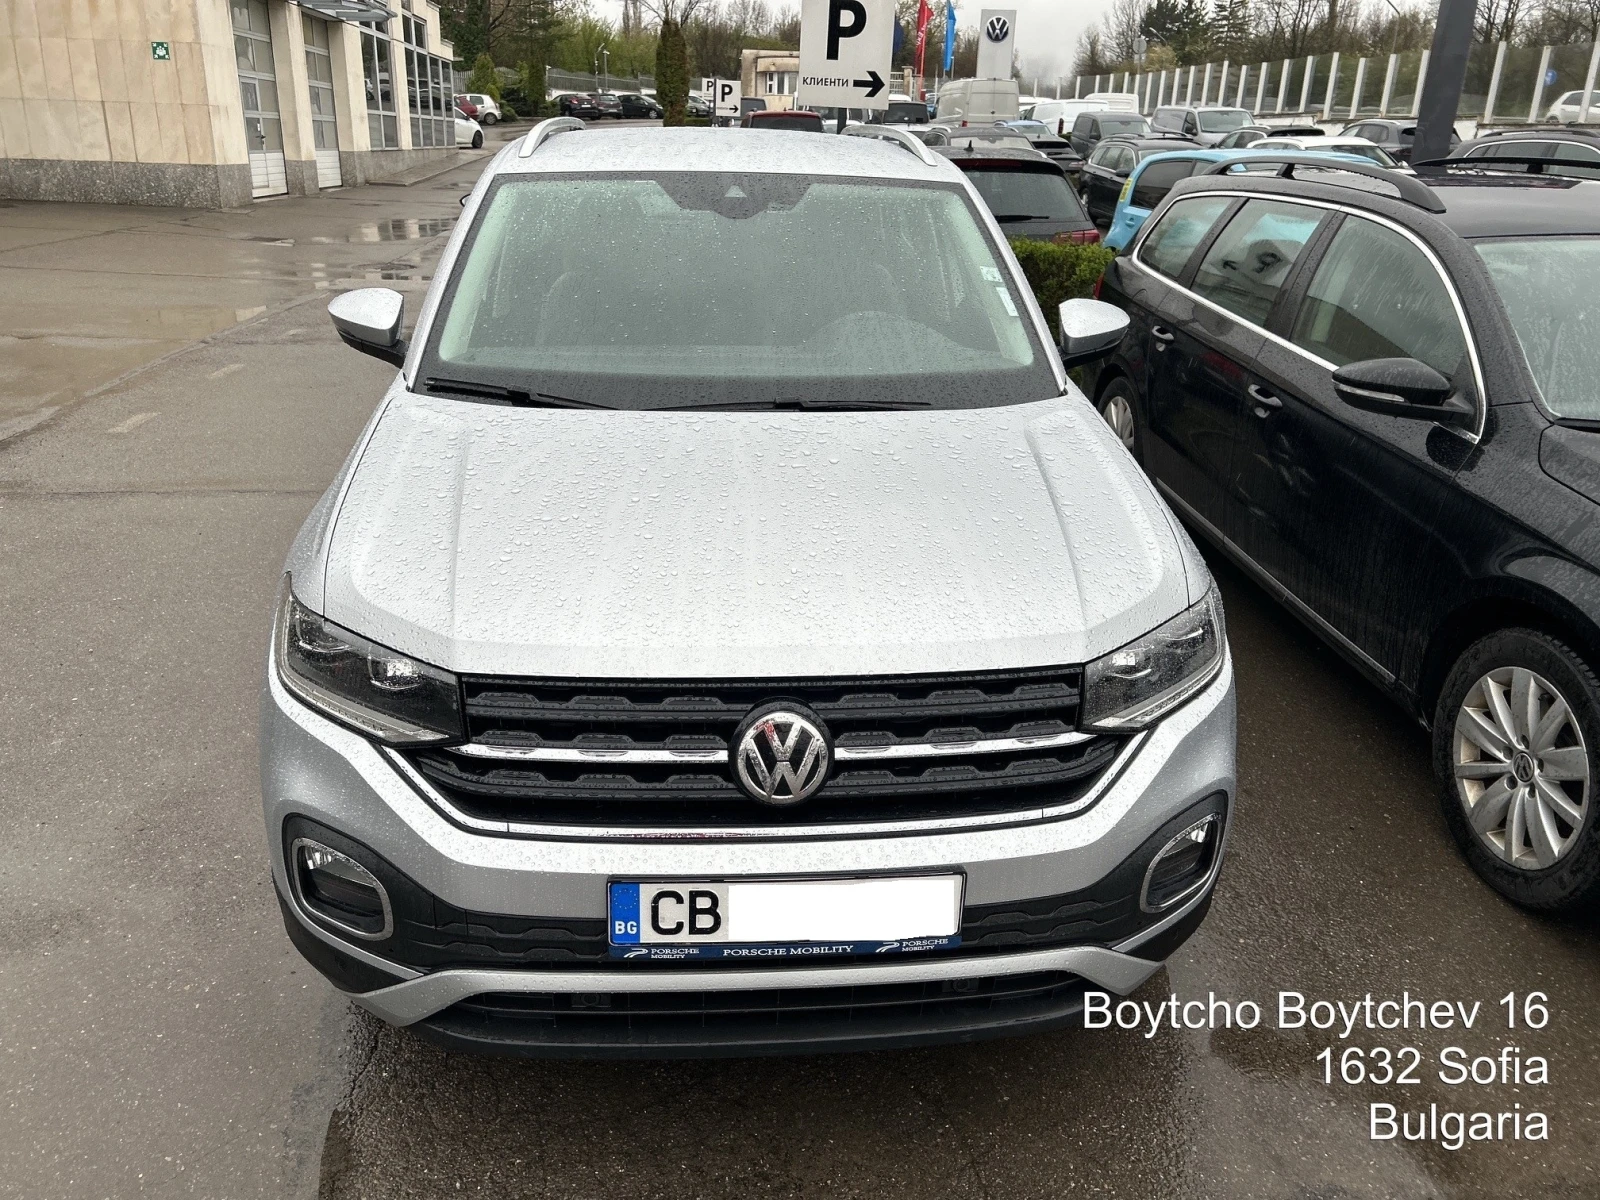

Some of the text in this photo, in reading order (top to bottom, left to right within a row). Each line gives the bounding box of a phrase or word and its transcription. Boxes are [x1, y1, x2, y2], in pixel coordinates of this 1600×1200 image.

[826, 0, 867, 60] P
[706, 80, 714, 92] P
[802, 77, 849, 87] КЛИЕНТИ
[721, 83, 733, 102] P
[738, 711, 828, 804] VW
[651, 890, 721, 935] CB
[615, 920, 637, 934] BG
[902, 938, 948, 947] PORSCHE
[723, 945, 854, 956] PORSCHE MOBILITY
